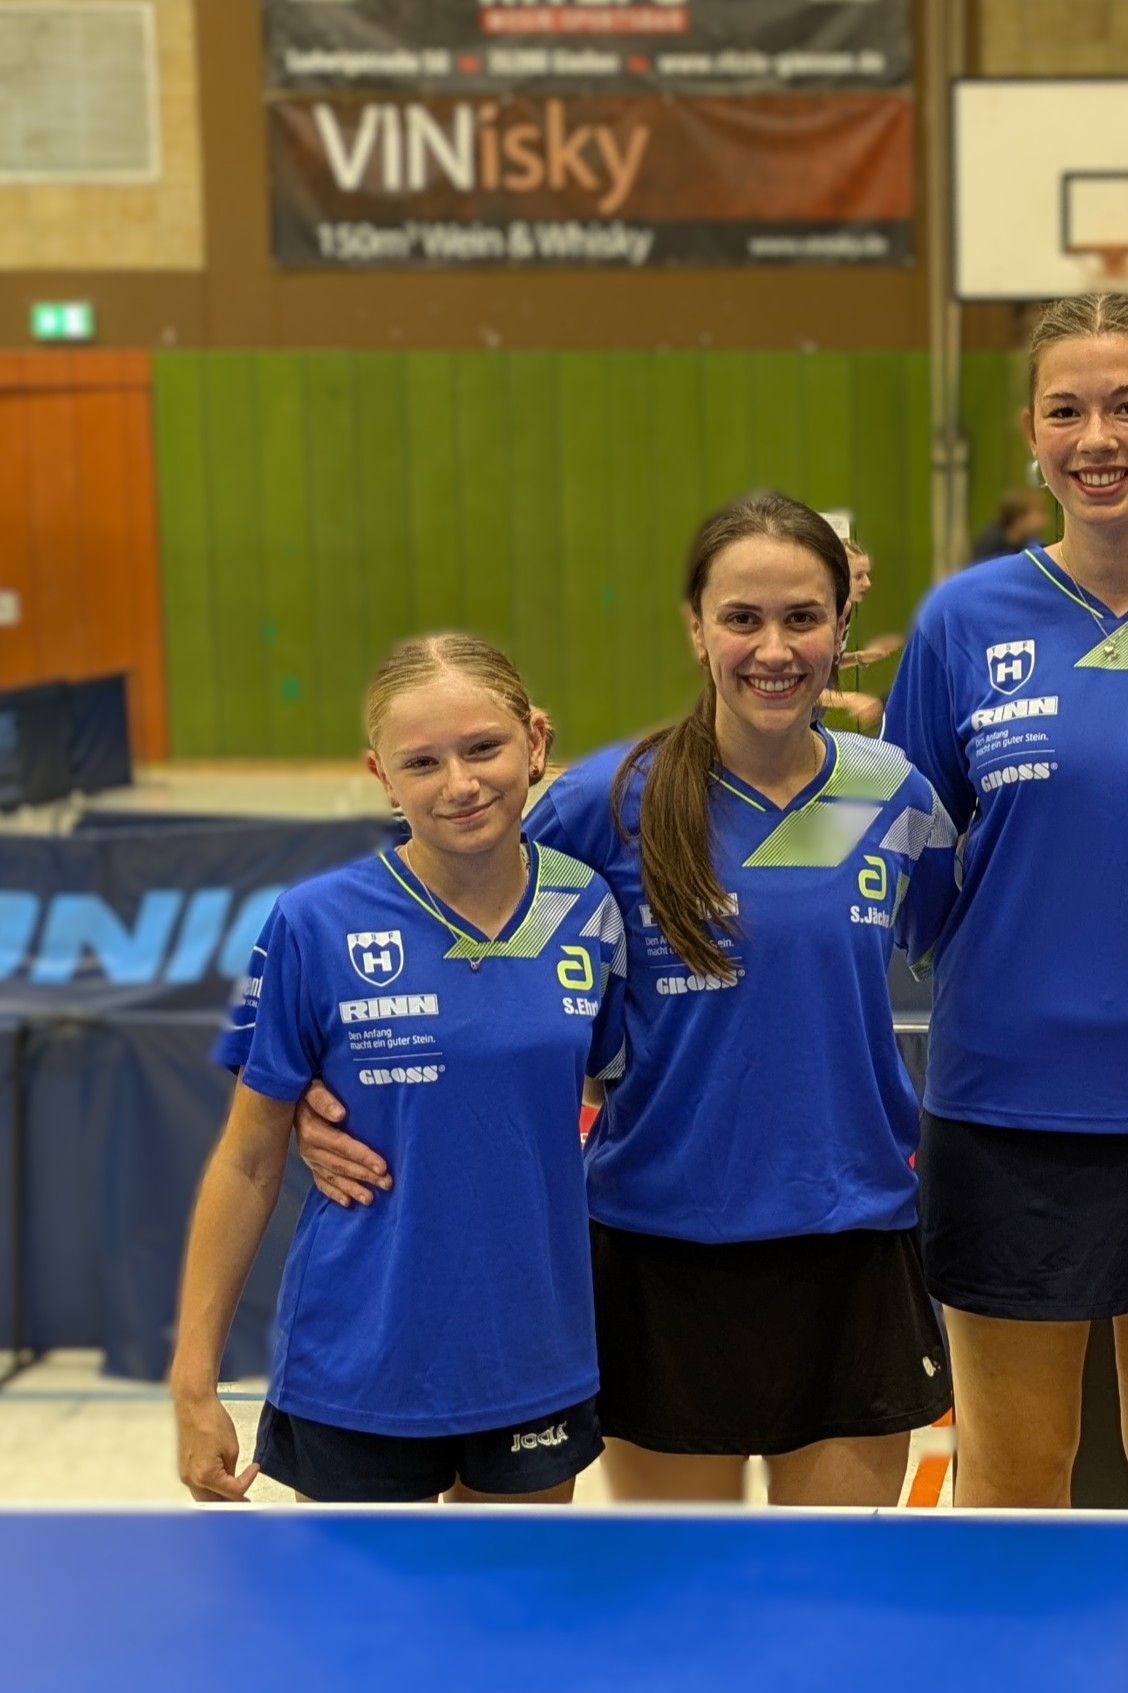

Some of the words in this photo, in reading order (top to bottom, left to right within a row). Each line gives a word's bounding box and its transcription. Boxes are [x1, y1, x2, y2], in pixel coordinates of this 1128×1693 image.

[313, 98, 650, 214] VINisky
[973, 696, 1057, 730] RINN
[1003, 735, 1024, 748] guter
[362, 950, 393, 974] H
[341, 995, 438, 1022] RINN
[350, 1041, 372, 1050] macht
[373, 1039, 386, 1048] ein
[387, 1036, 411, 1049] guter
[412, 1034, 436, 1045] Stein.
[363, 1028, 392, 1038] Anfang
